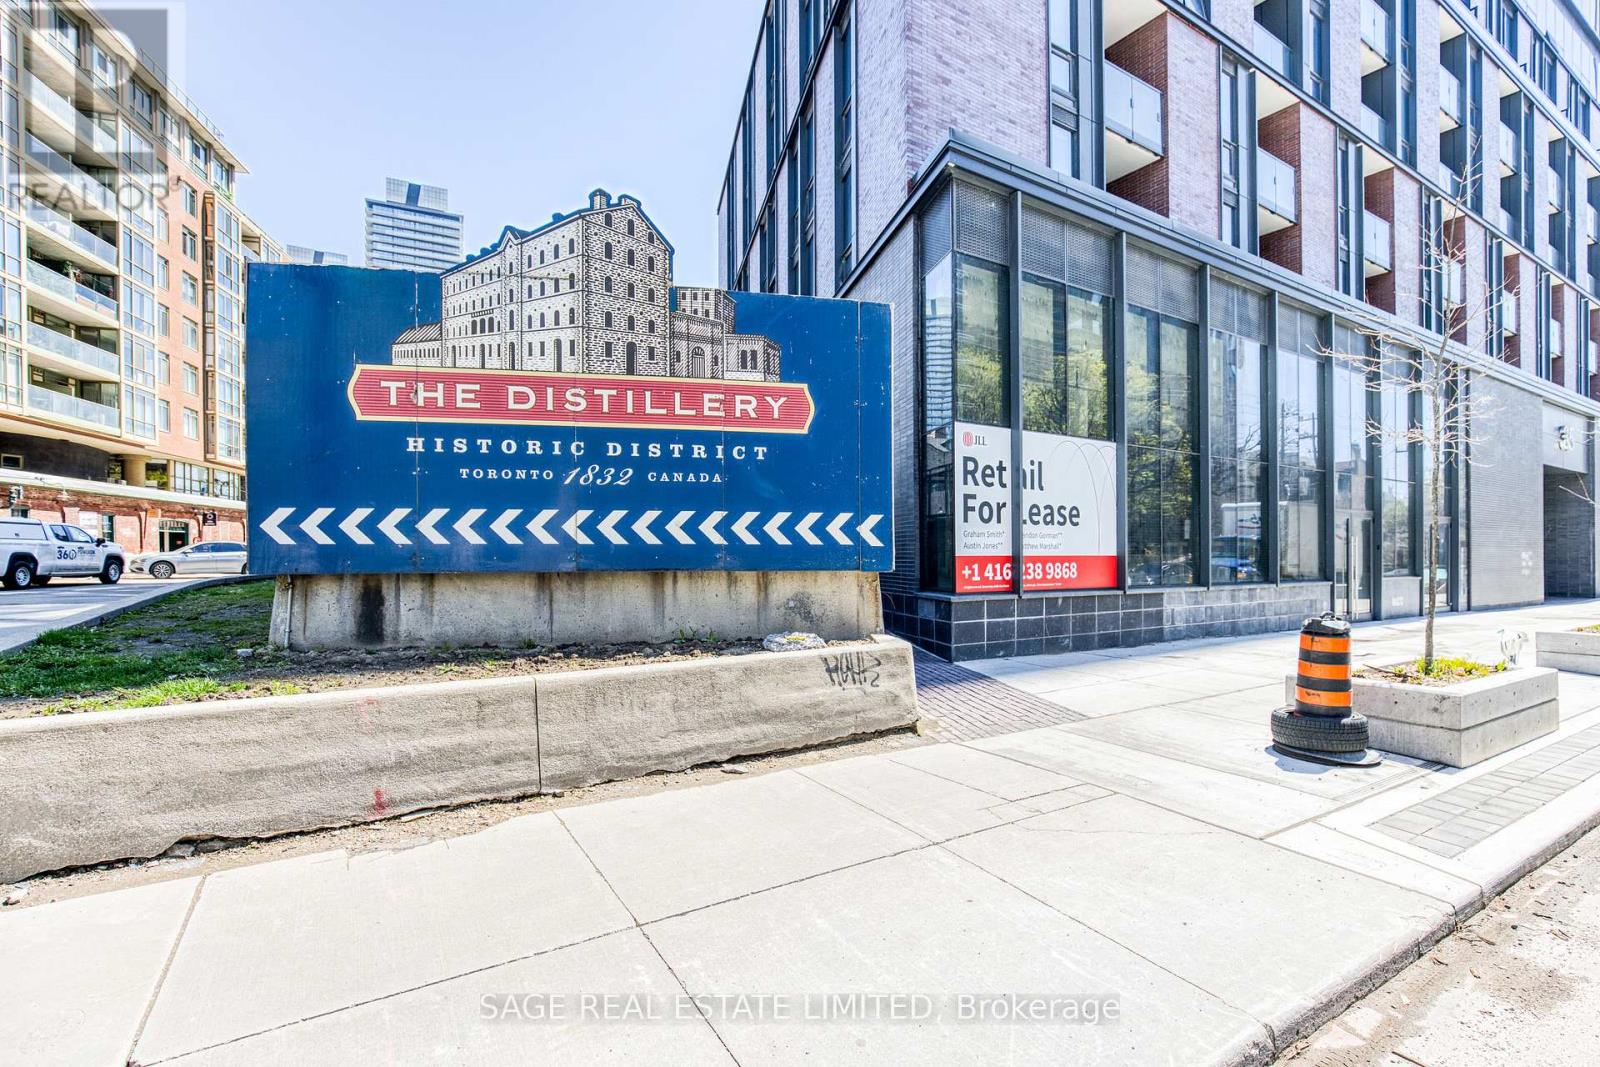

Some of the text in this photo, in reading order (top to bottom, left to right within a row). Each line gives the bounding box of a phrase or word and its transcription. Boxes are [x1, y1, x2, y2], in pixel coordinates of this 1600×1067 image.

[380, 380, 788, 420] THE DISTILLERY
[406, 437, 767, 460] HISTORIC DISTRICT
[974, 435, 988, 446] JLL
[460, 464, 722, 486] TORONTO 1832 CANADA
[963, 493, 1081, 527] For ease
[963, 530, 986, 538] Graham
[962, 563, 981, 581] +1
[984, 562, 1012, 581] 416
[1045, 561, 1077, 580] 9868
